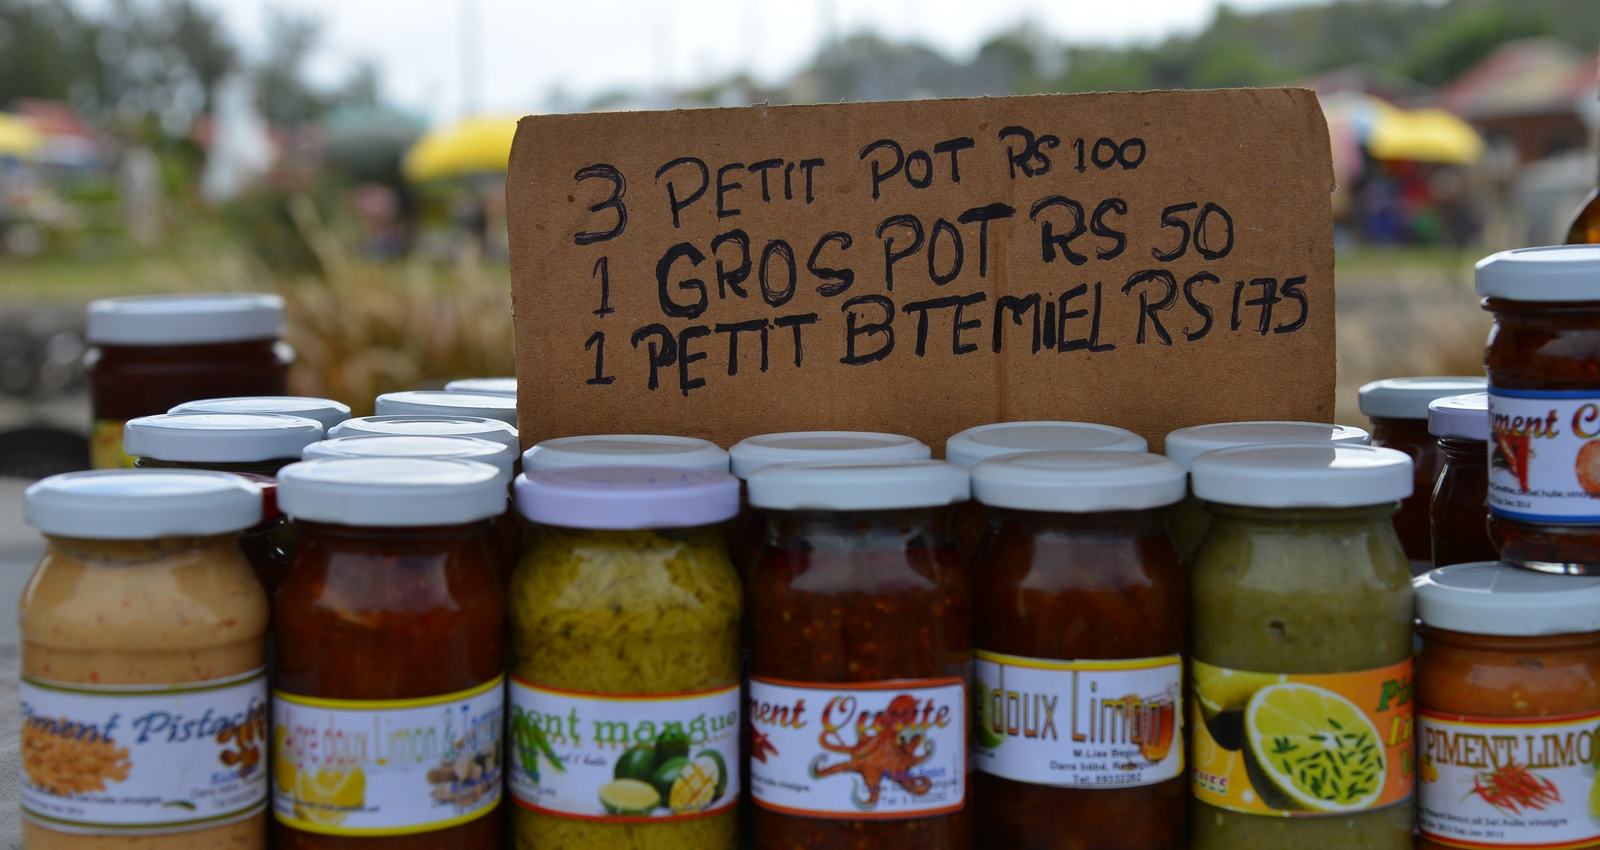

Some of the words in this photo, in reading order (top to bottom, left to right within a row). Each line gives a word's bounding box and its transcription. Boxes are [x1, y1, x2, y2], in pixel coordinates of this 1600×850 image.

[574, 163, 627, 246] 3
[654, 157, 826, 229] PETIT
[859, 137, 975, 202] POT
[997, 126, 1061, 182] RS
[1071, 137, 1147, 174] 100
[592, 256, 614, 318] 1
[656, 229, 855, 320] GROS
[876, 202, 1016, 291] POT
[1029, 195, 1128, 267] RS
[1151, 200, 1235, 263] 50
[585, 331, 616, 386] 1
[631, 312, 822, 397] PETIT
[1119, 269, 1221, 347] RS
[1231, 275, 1310, 337] 175
[593, 710, 738, 747] mangue
[992, 664, 1059, 741] doux
[1072, 671, 1162, 748] Limon
[1424, 726, 1523, 769] PIMENT
